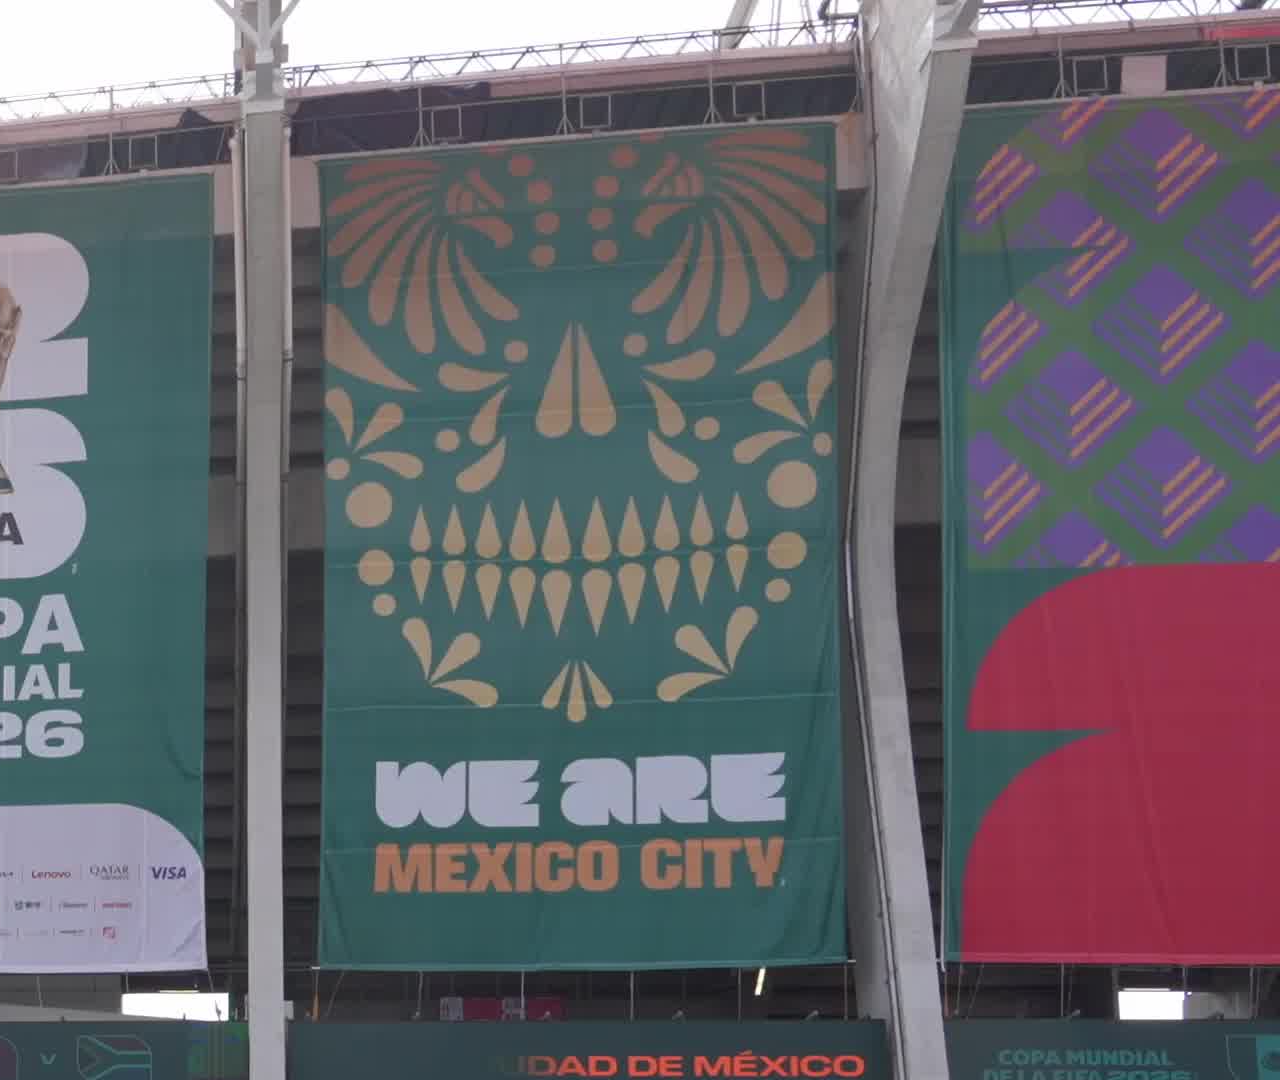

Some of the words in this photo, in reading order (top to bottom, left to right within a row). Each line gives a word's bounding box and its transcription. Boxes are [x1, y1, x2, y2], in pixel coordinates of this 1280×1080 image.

[376, 760, 539, 828] WE
[31, 870, 72, 880] Lenovo
[151, 866, 187, 880] VISA
[374, 840, 620, 893] MEXICO
[640, 837, 784, 889] CITY
[628, 1055, 683, 1077] DE
[694, 1050, 865, 1077] MÉXICO
[999, 1049, 1061, 1065] COPA
[1066, 1049, 1172, 1065] MUNDIAL
